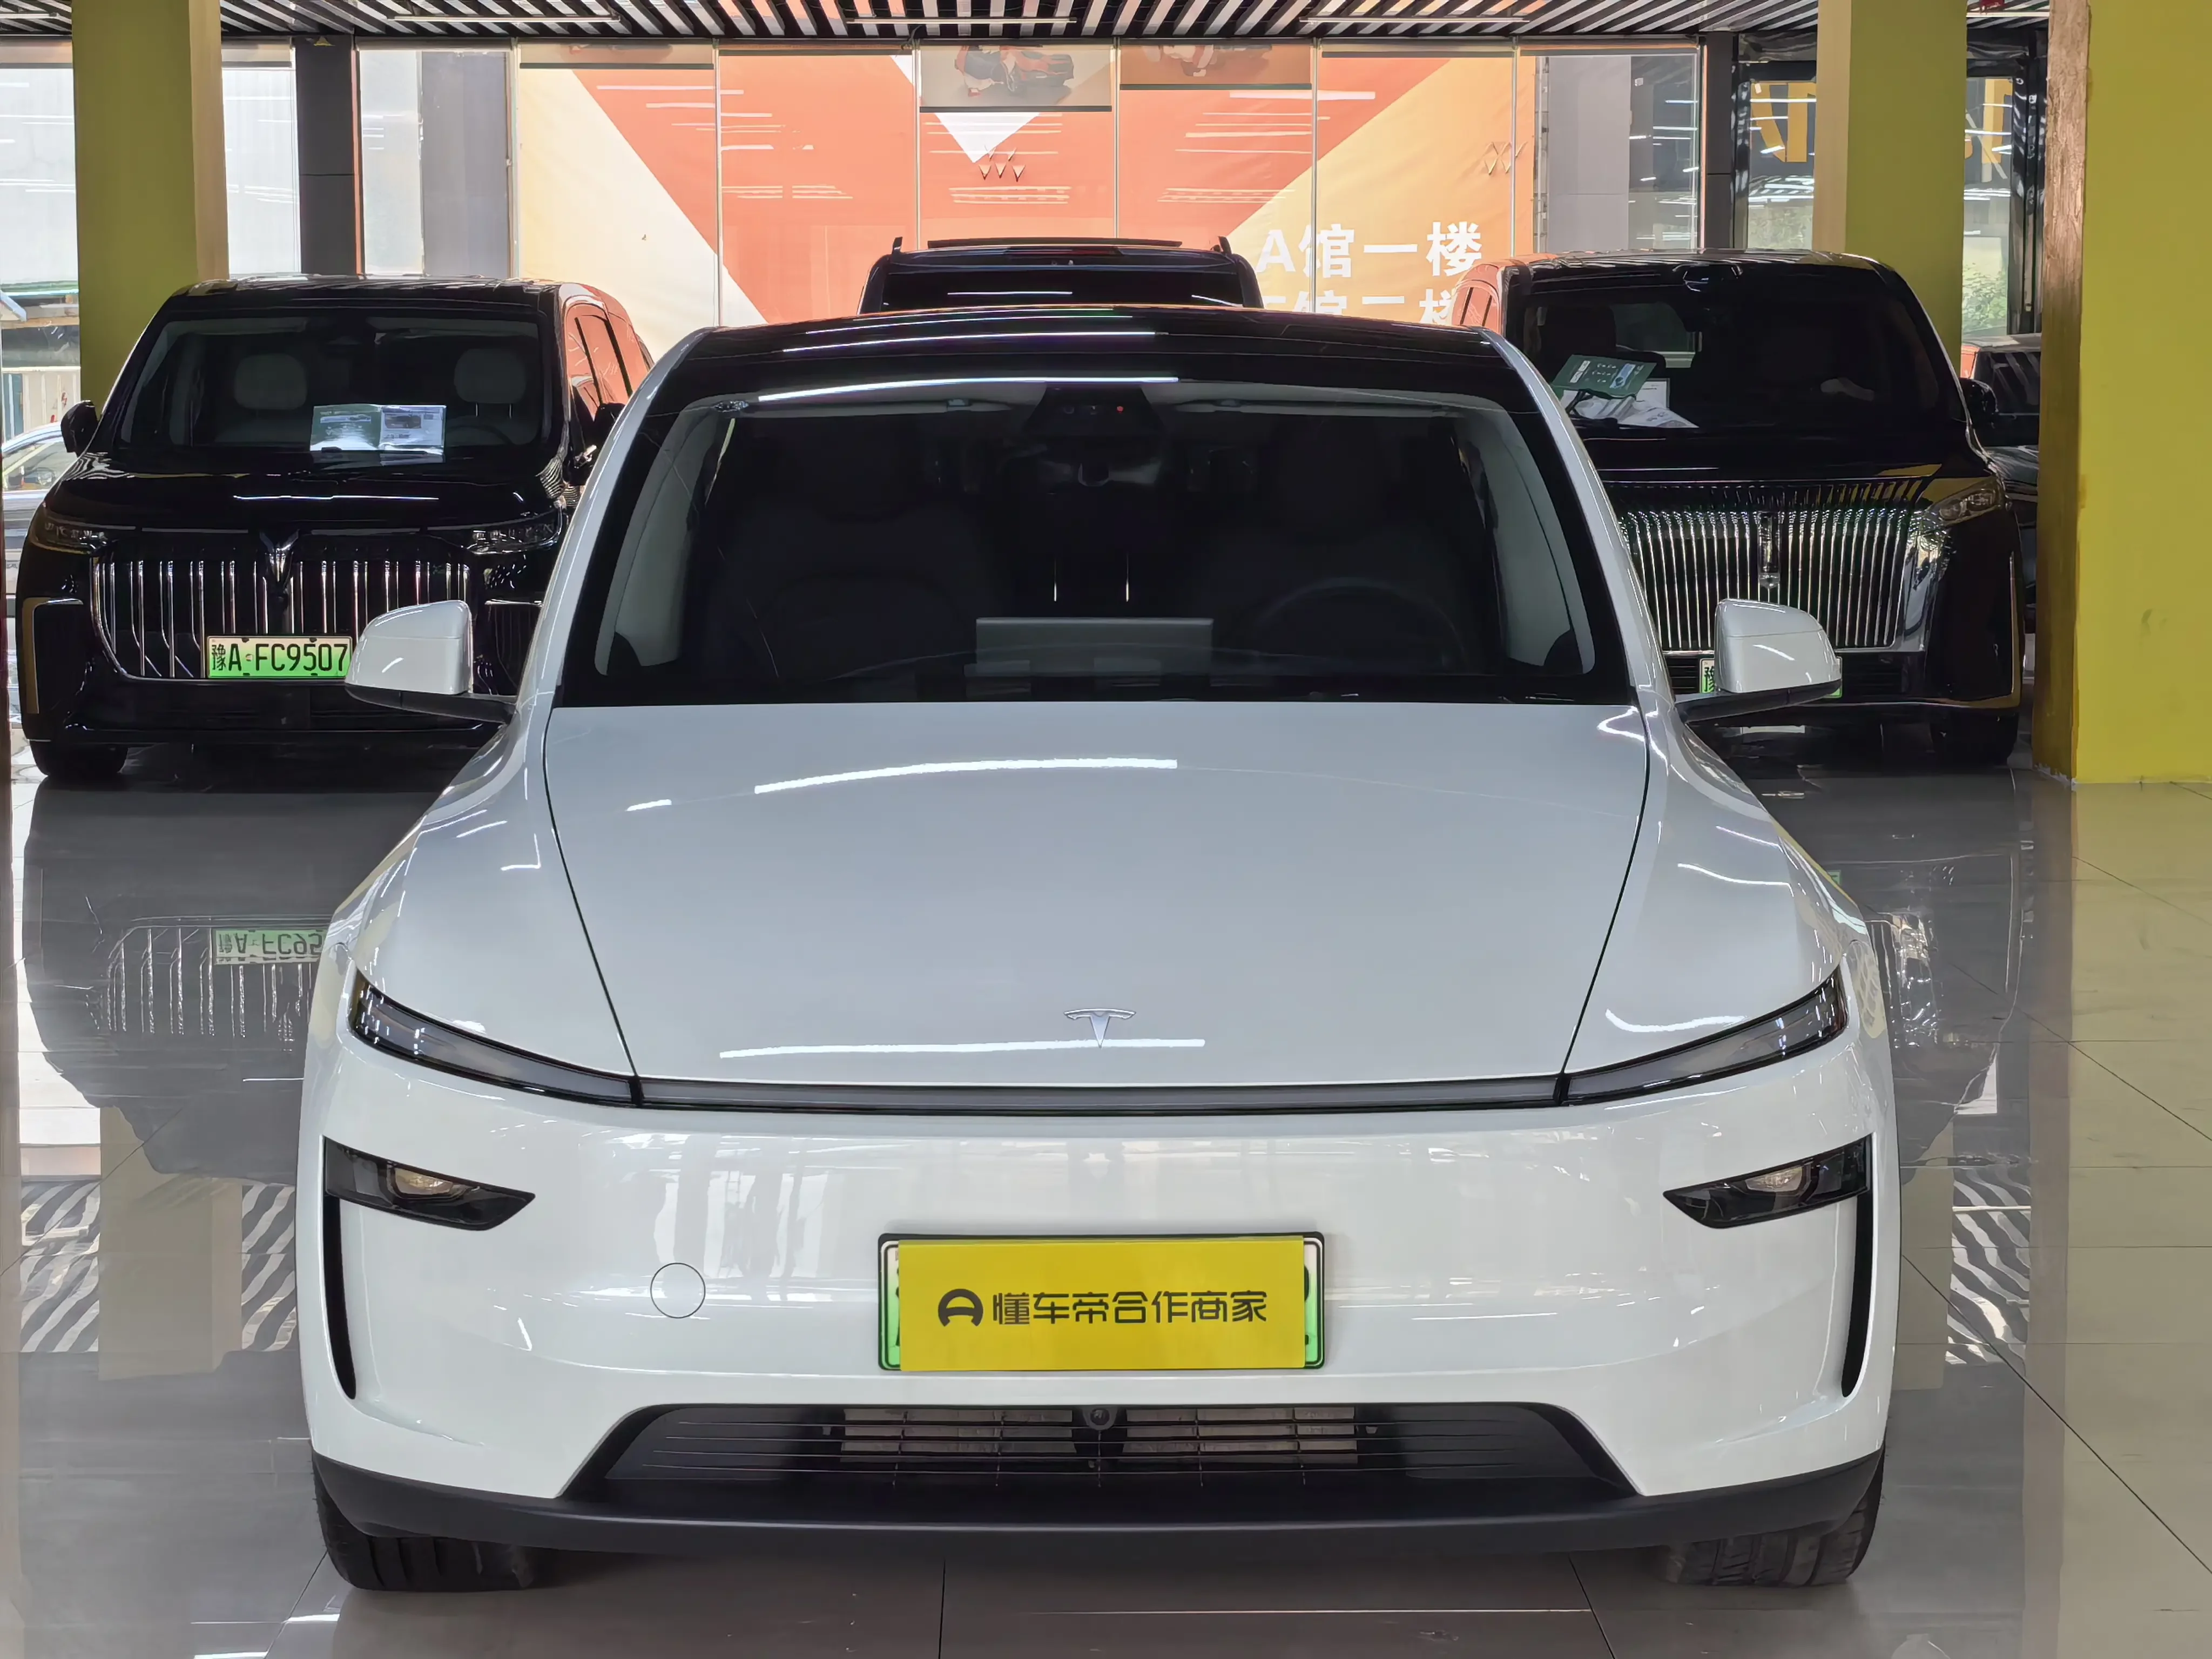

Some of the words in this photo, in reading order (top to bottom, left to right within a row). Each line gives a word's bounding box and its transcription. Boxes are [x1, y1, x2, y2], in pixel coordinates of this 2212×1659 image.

[1256, 221, 1482, 279] A馆一楼
[993, 1290, 1267, 1325] 懂车帝合作商家
